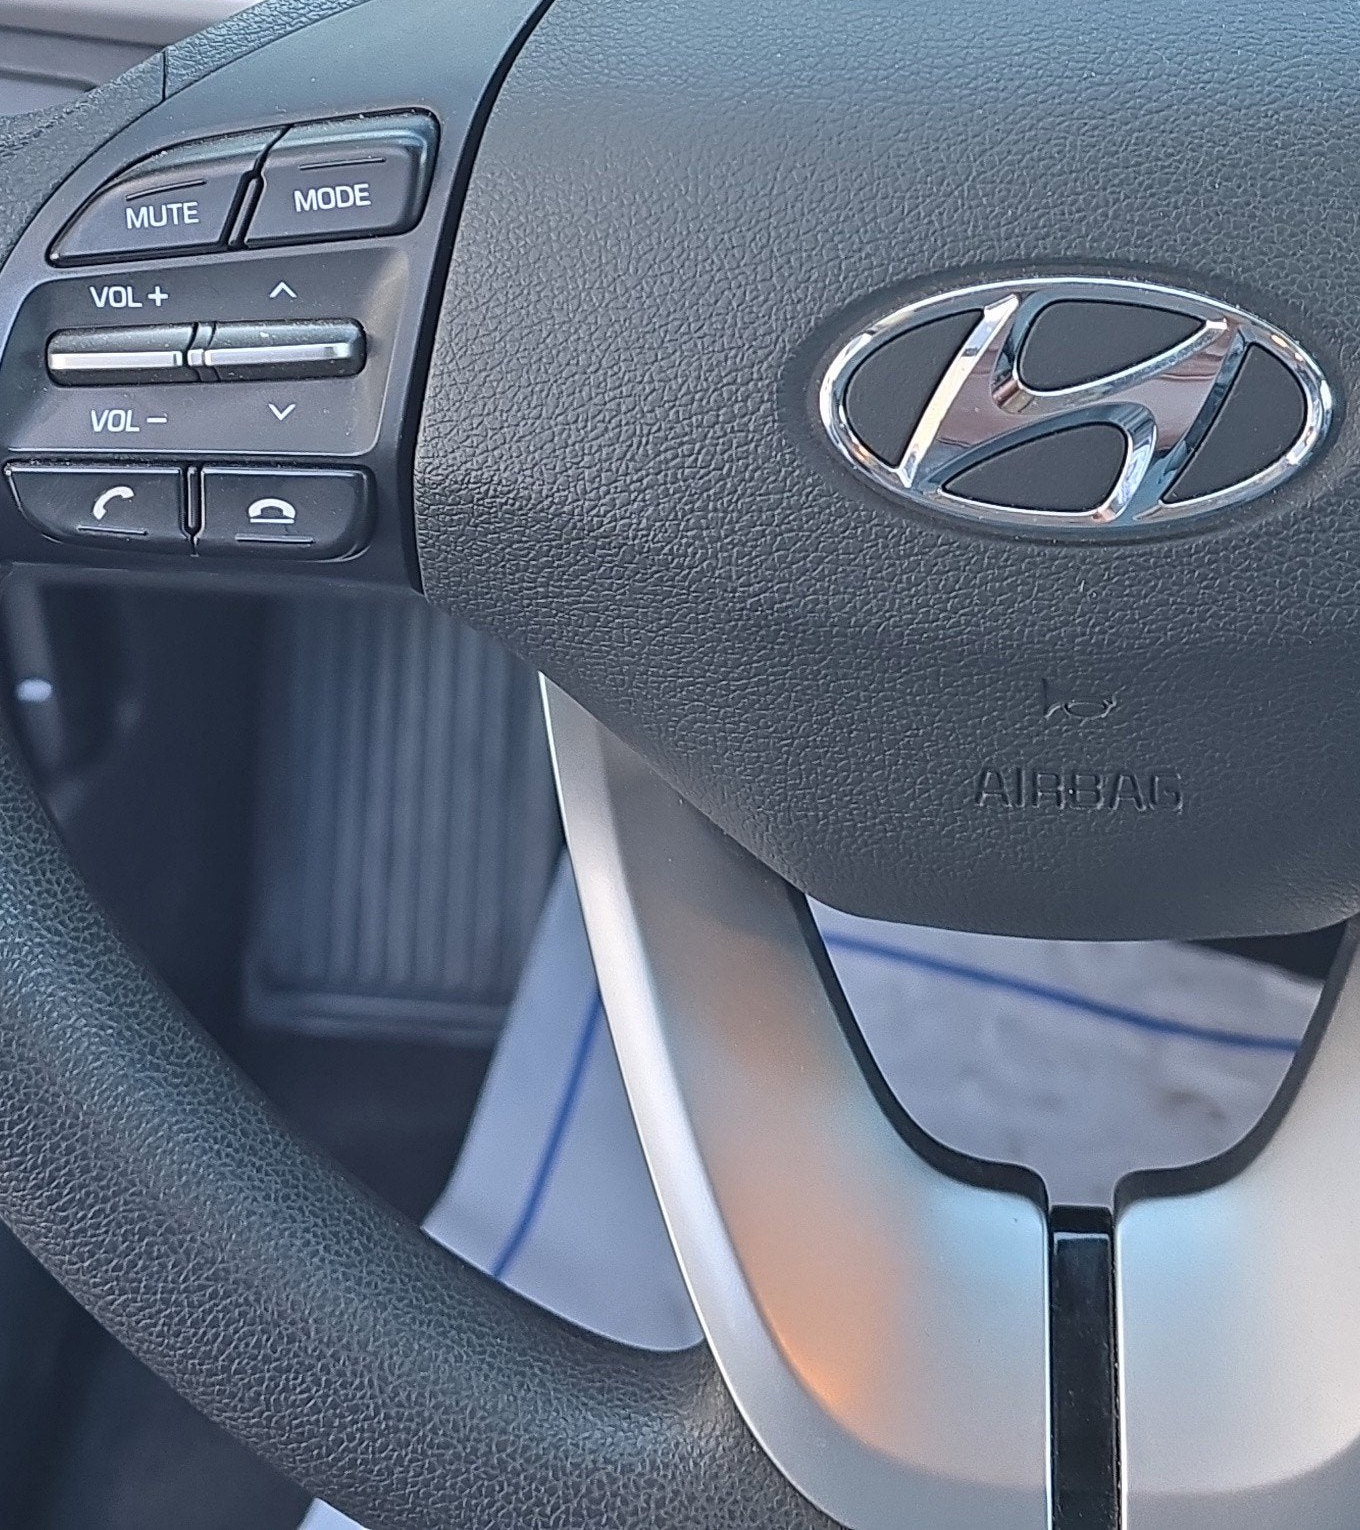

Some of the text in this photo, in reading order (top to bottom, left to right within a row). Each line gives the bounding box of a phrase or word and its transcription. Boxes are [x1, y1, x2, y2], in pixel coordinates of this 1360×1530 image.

[293, 183, 372, 213] MODE
[125, 201, 200, 230] MUTE
[974, 767, 1184, 813] AIRBAG
